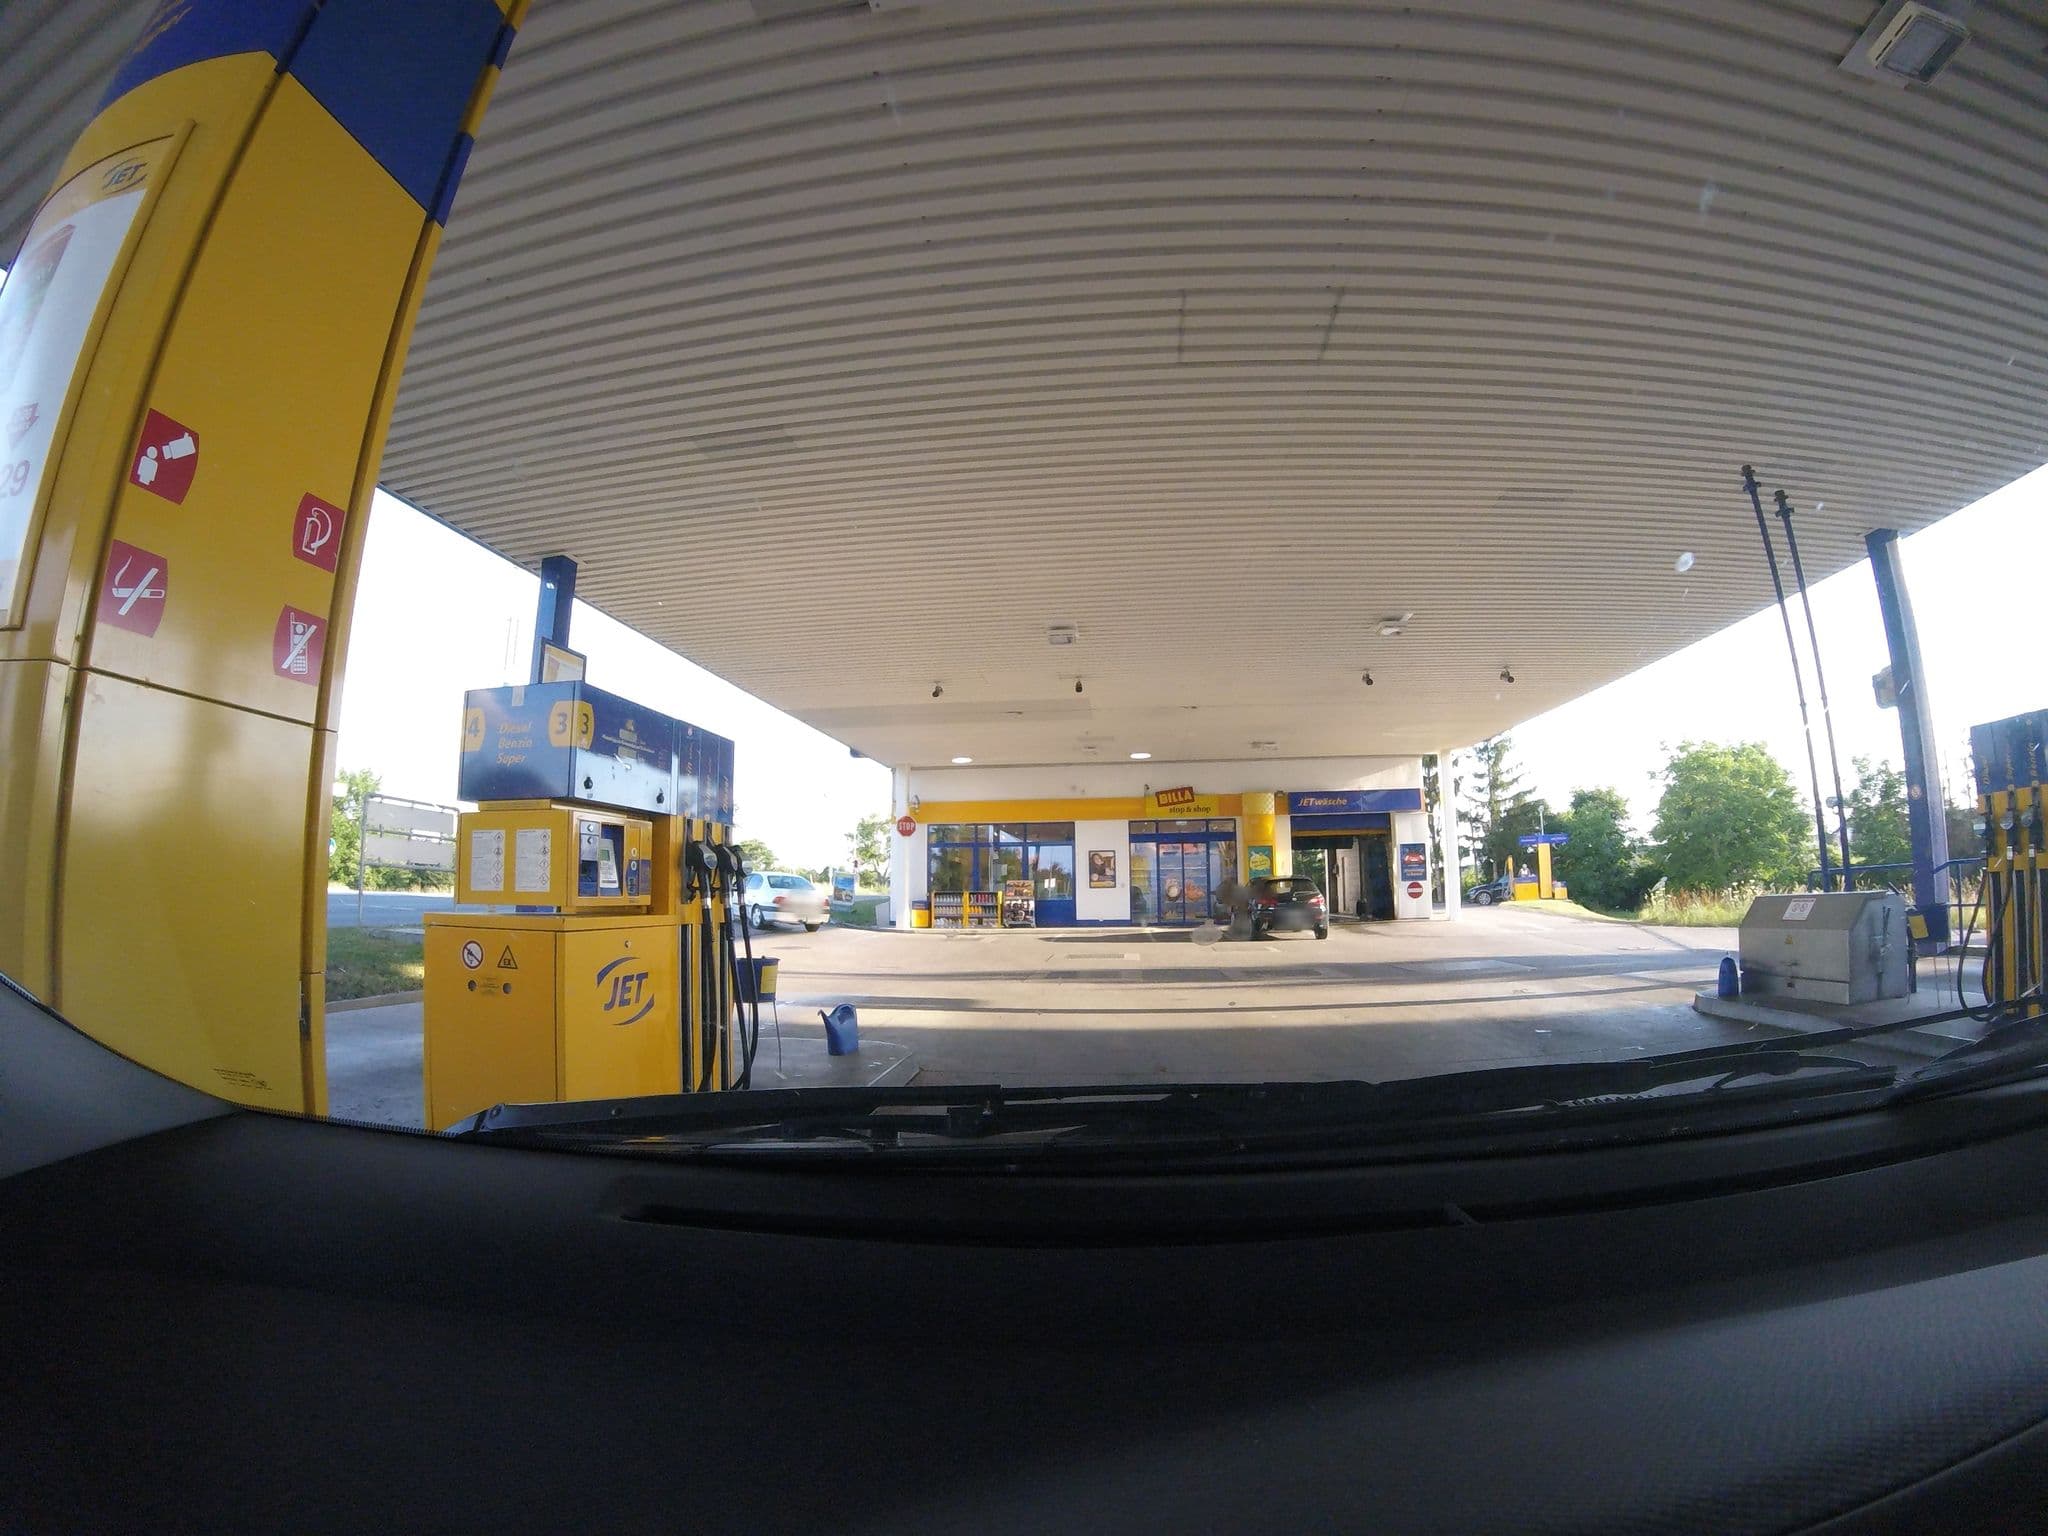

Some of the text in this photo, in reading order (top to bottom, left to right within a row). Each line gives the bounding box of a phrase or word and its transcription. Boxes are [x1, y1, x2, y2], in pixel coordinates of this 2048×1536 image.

[468, 715, 480, 738] 4
[556, 712, 568, 735] 3
[581, 713, 590, 735] 3
[498, 737, 533, 749] Benzin
[496, 752, 526, 767] Super
[1158, 789, 1193, 804] BILLA
[1169, 806, 1185, 814] stop
[1193, 805, 1211, 814] shop
[899, 822, 915, 831] STOP
[603, 972, 648, 1011] JET
